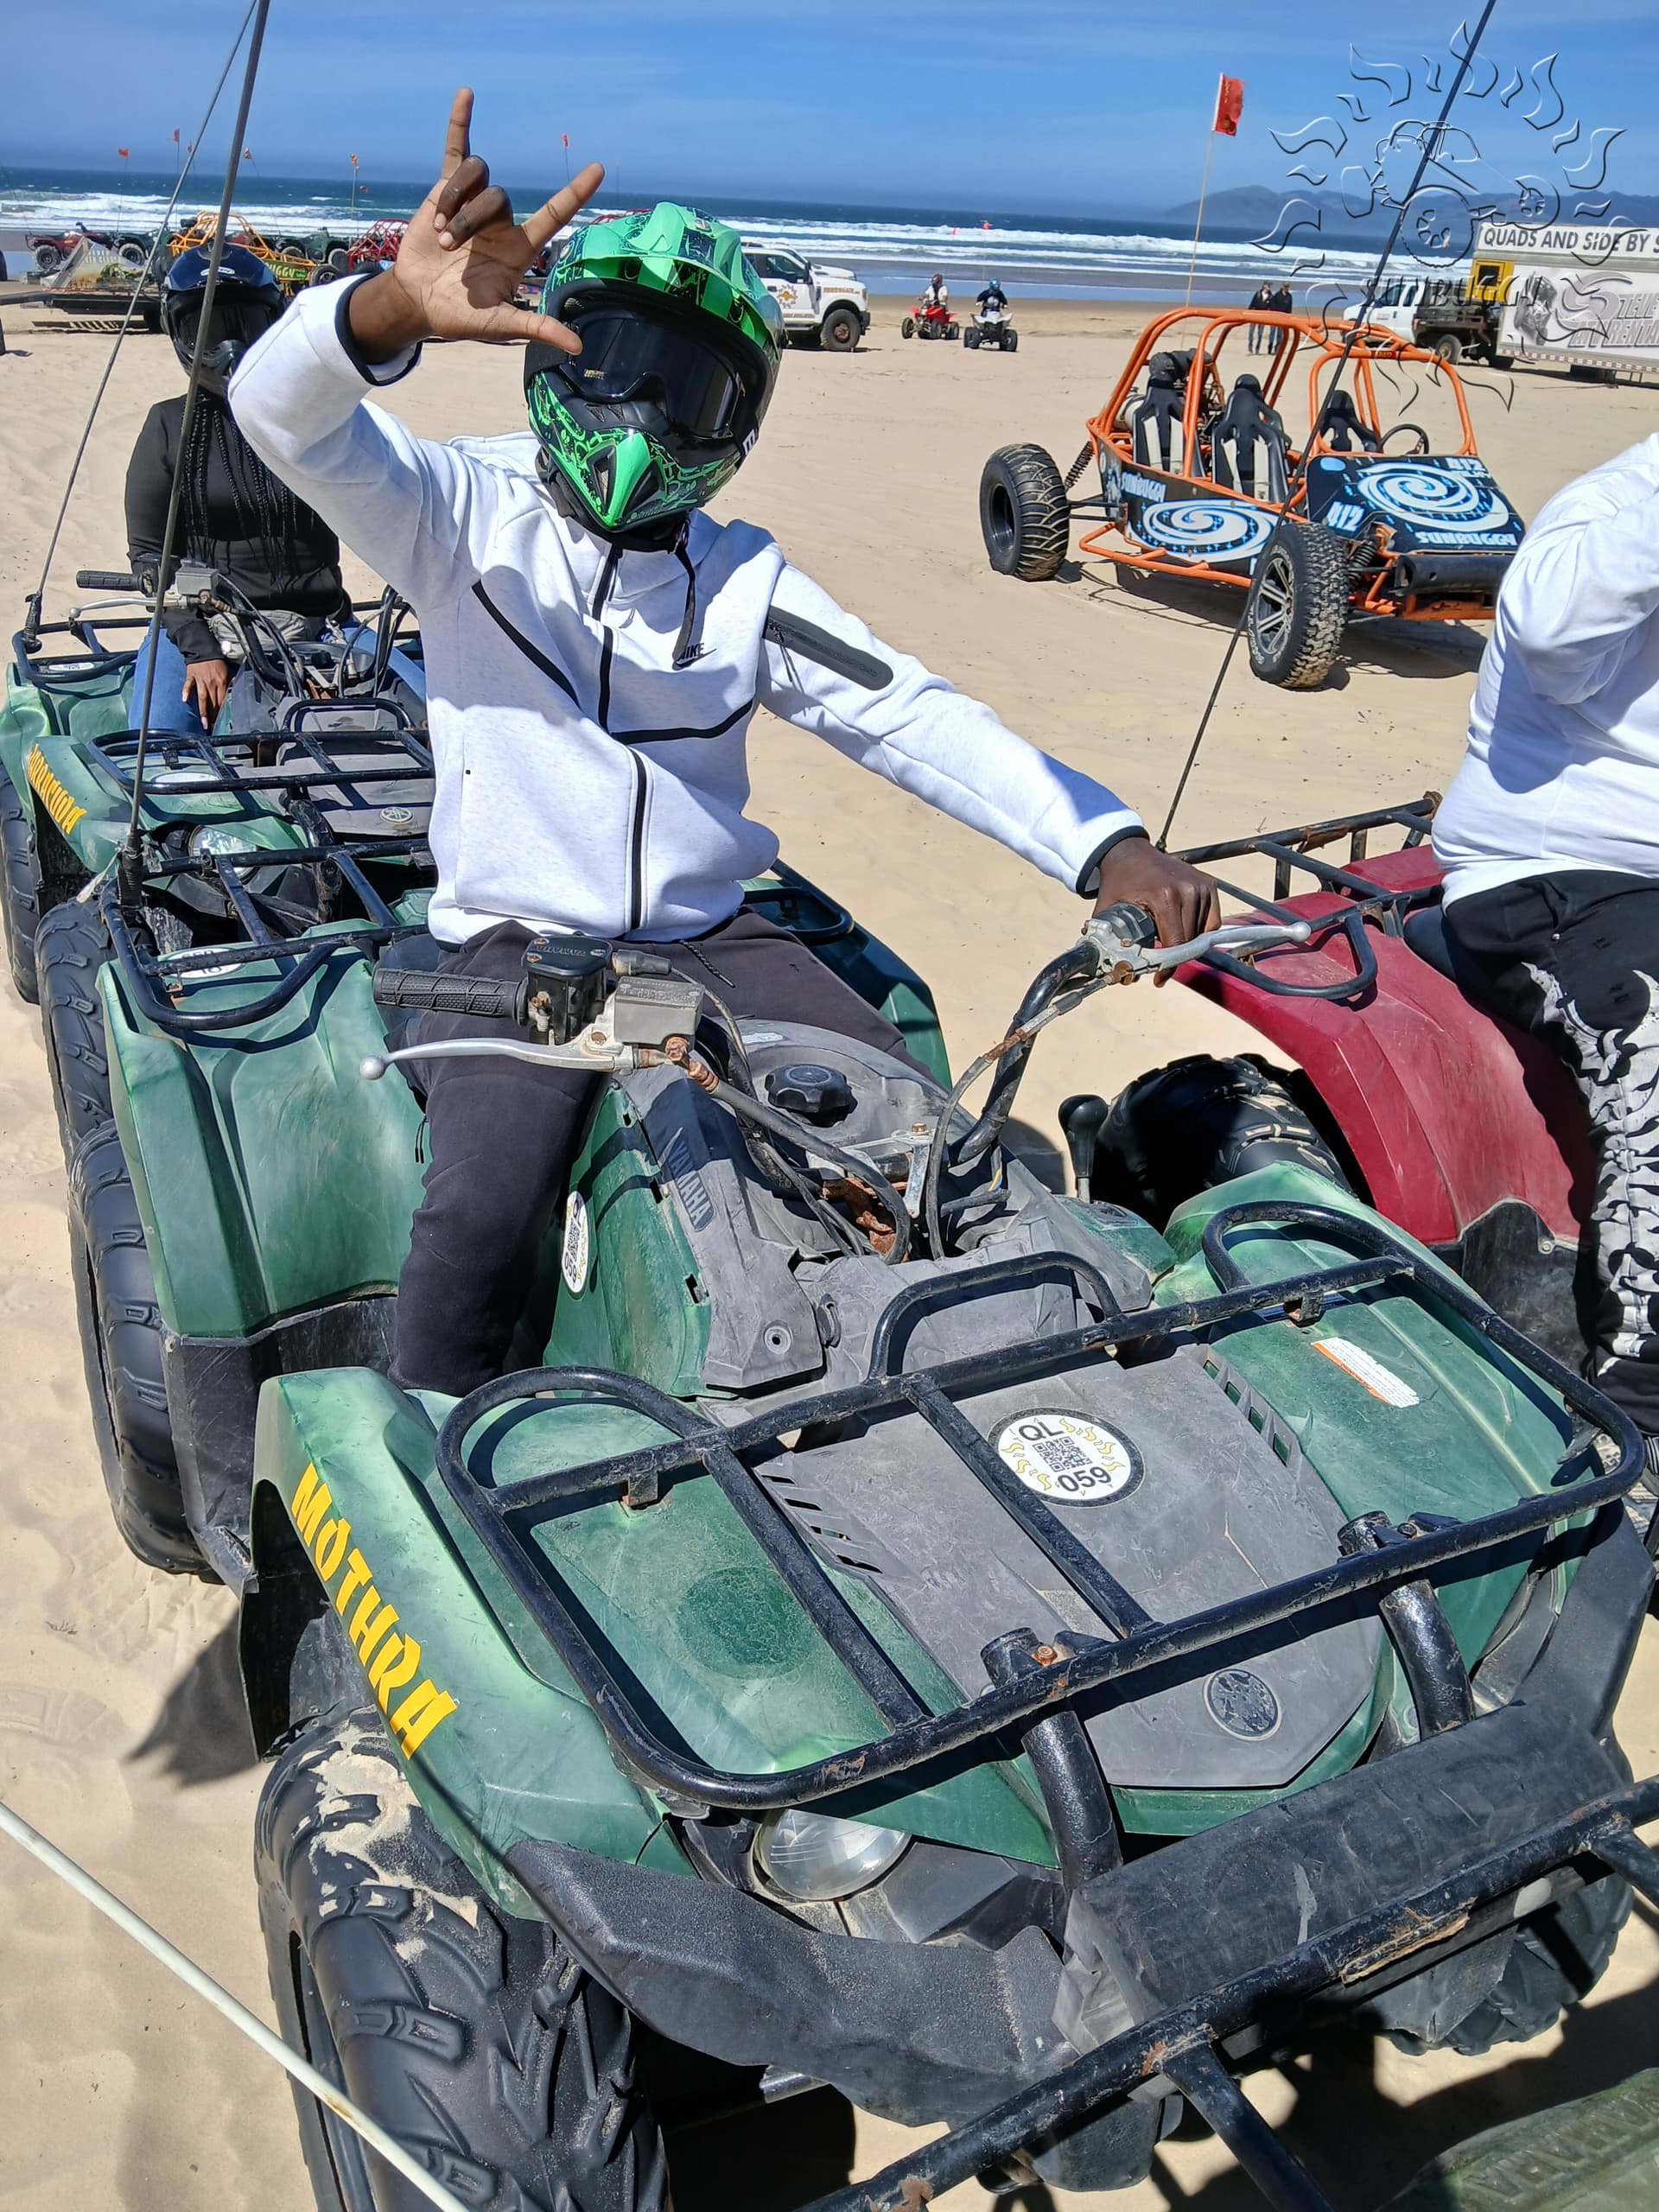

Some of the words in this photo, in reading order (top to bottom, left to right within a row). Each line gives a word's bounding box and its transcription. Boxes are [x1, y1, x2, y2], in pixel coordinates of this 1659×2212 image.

[1484, 227, 1537, 247] QUADS
[1541, 230, 1579, 250] AND
[1583, 232, 1621, 251] SIDE
[1626, 234, 1651, 253] BY
[1414, 531, 1517, 546] SUNBUGGY
[668, 1140, 711, 1226] YAMAHA
[1018, 1421, 1065, 1441] QL
[1057, 1466, 1112, 1492] 059
[291, 1461, 459, 1761] MOTHRA
